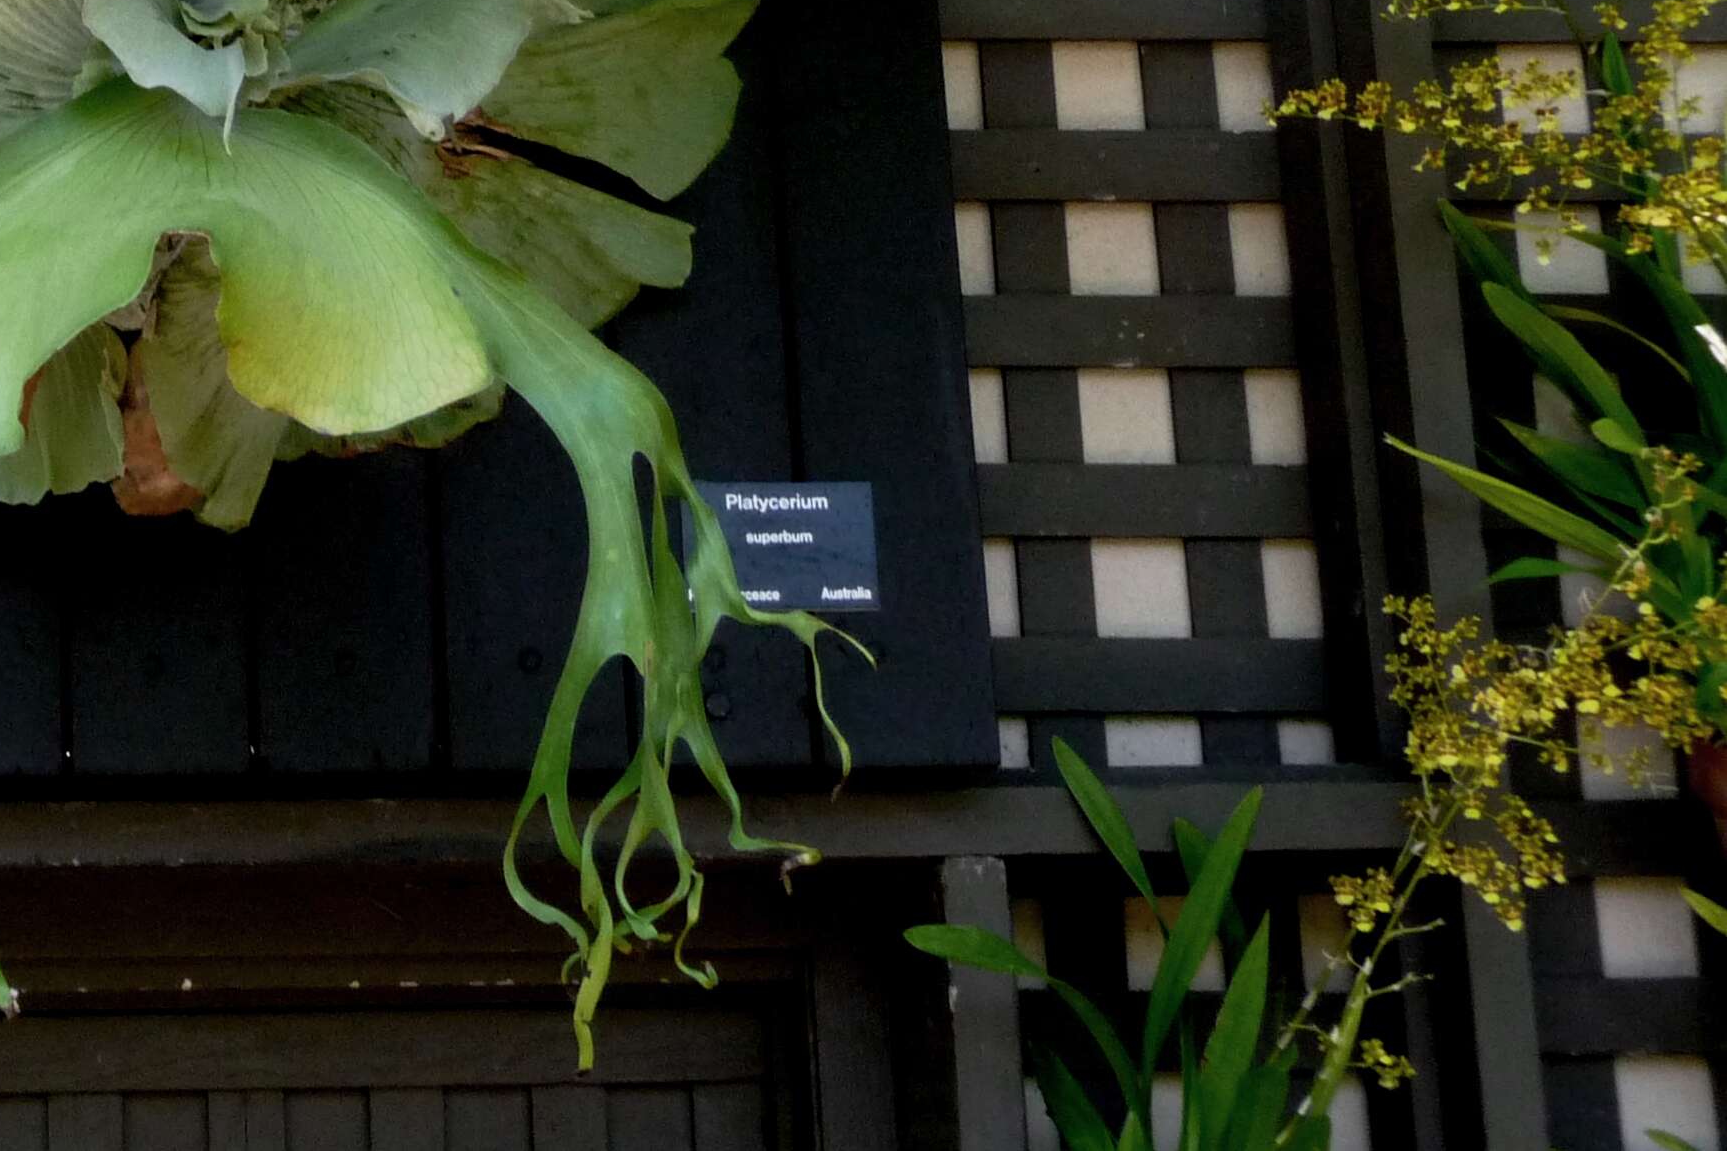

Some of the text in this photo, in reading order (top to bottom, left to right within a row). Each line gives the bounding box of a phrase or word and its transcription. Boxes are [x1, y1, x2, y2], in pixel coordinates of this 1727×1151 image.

[725, 493, 829, 513] Platycerium
[746, 530, 813, 545] superbum
[821, 586, 872, 600] Australia
